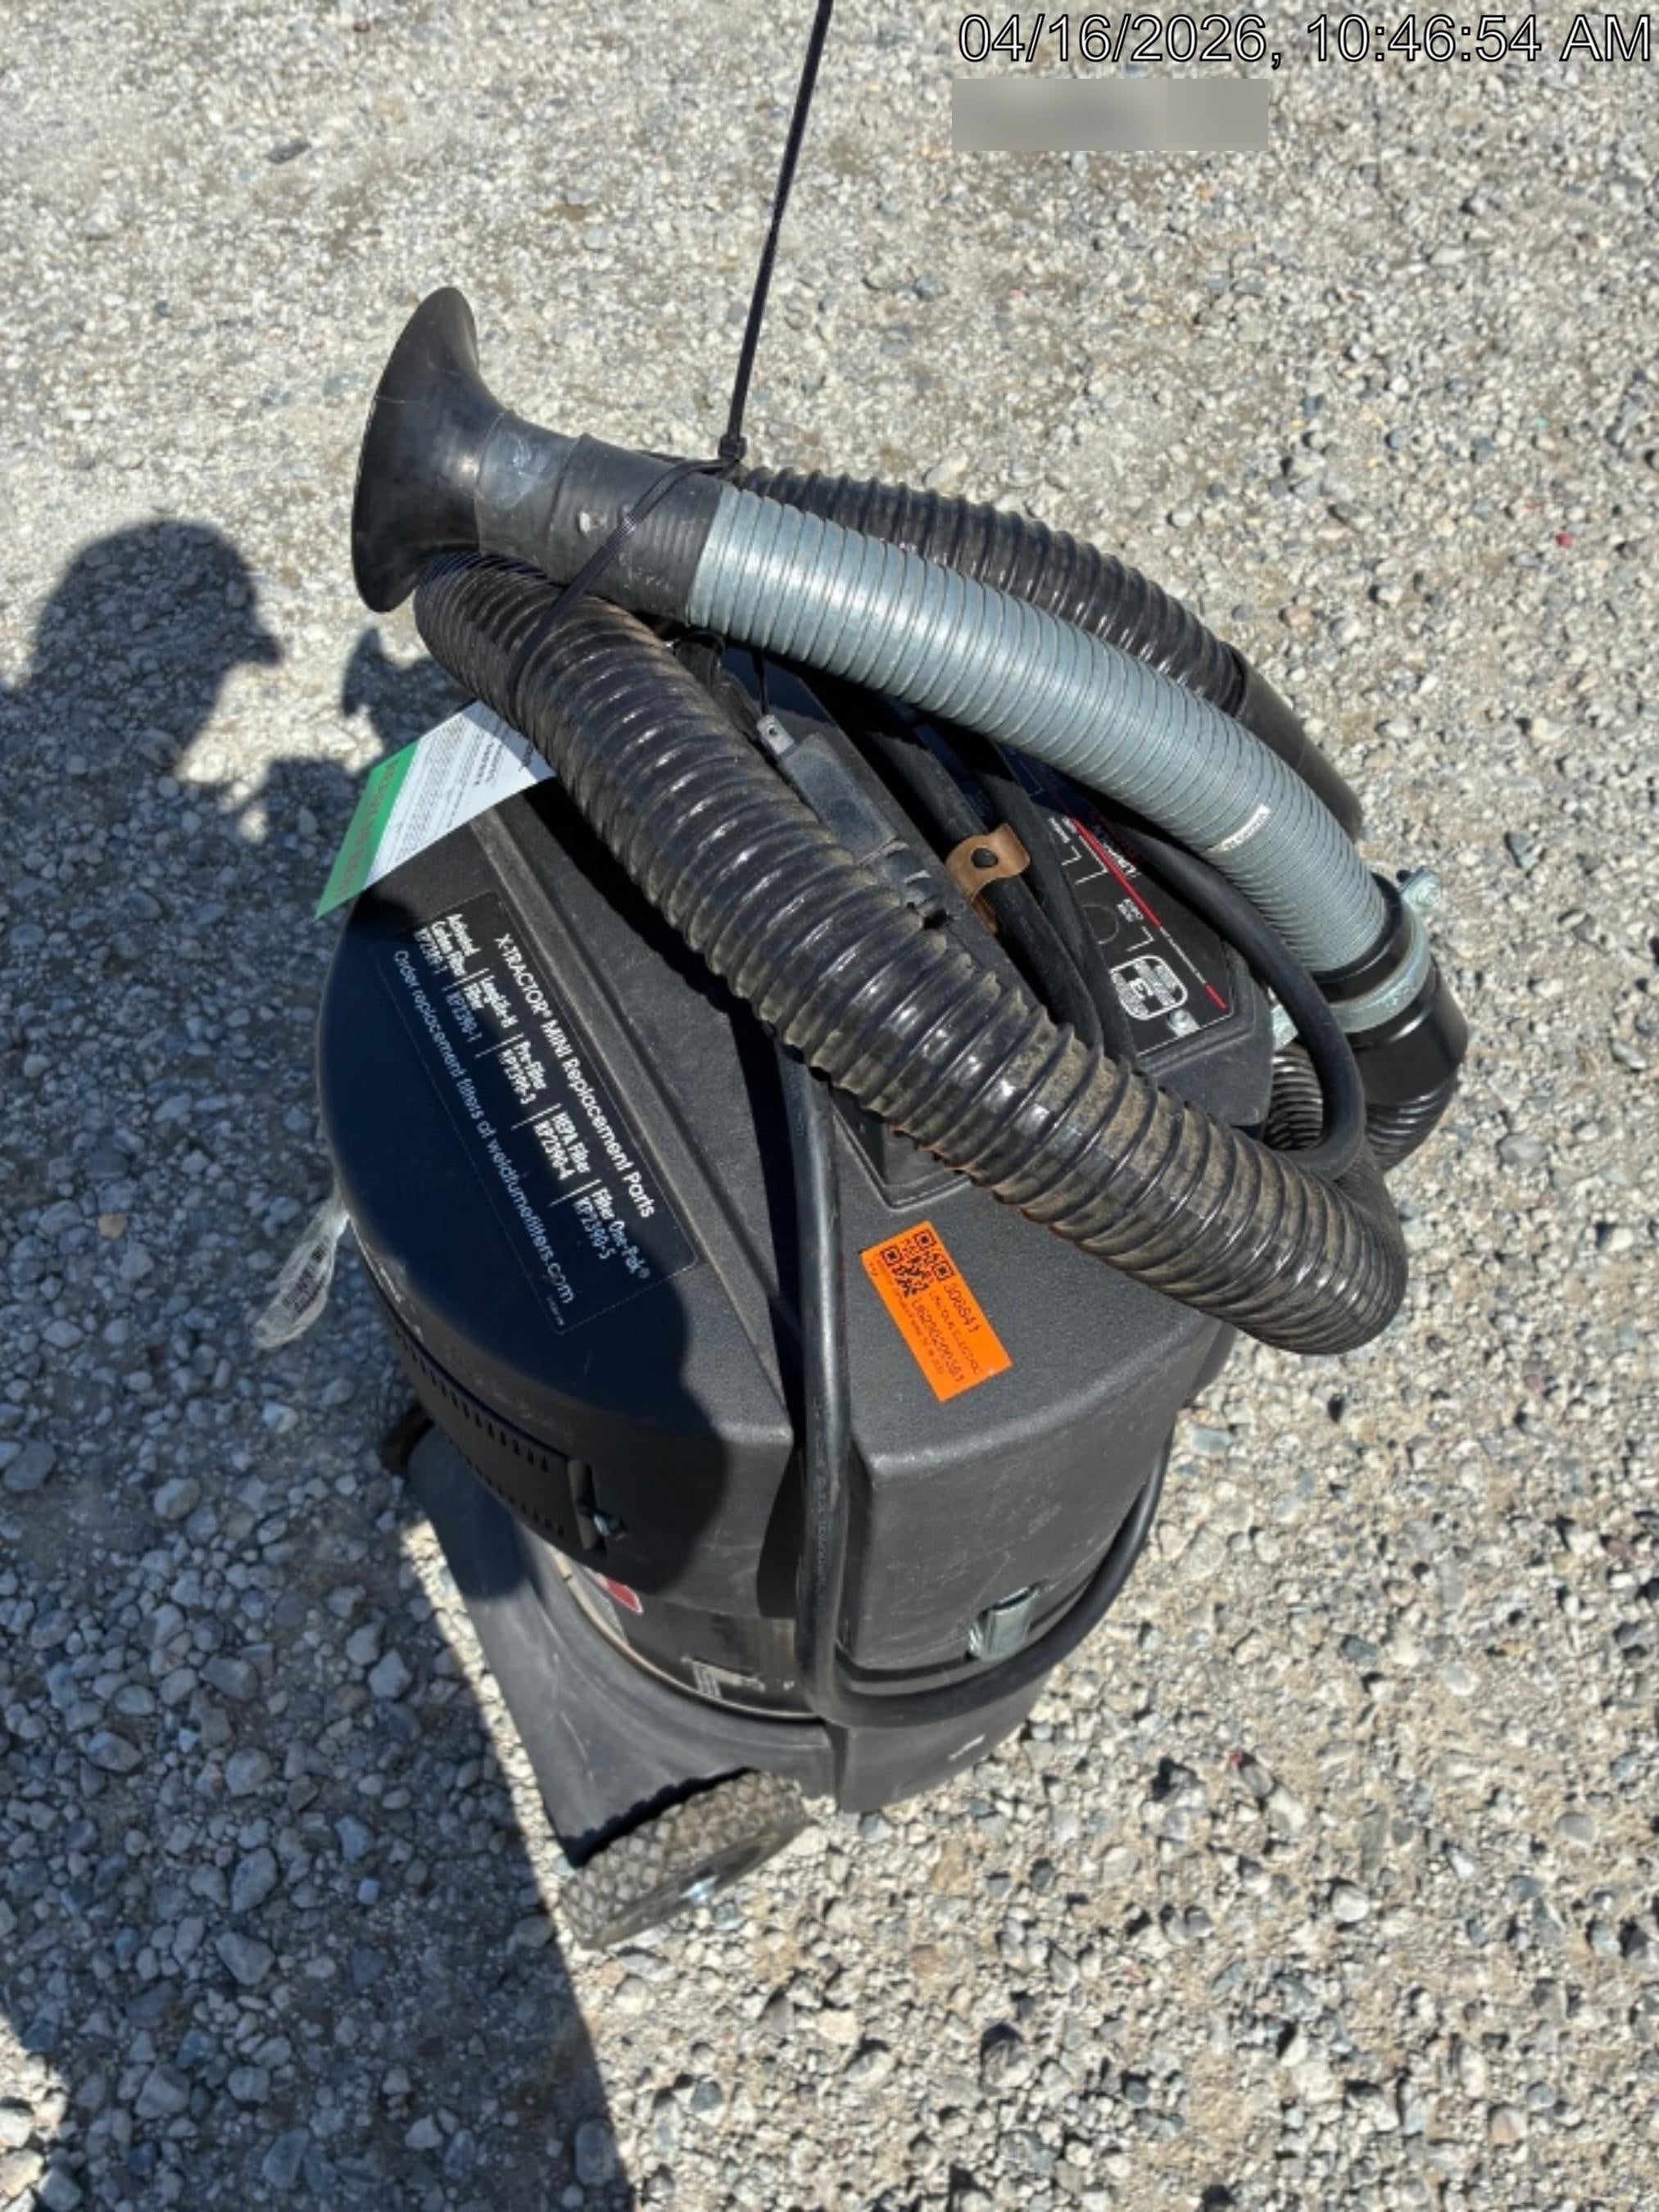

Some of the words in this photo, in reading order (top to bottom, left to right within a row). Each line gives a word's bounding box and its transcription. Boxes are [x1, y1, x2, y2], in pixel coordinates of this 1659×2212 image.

[394, 950, 419, 987] Order
[412, 990, 466, 1077] replacement
[456, 1078, 484, 1119] filters
[477, 1121, 496, 1138] at
[487, 1139, 573, 1303] weldfumefilters.com
[542, 1020, 573, 1058] MINI
[562, 1057, 633, 1171] Replacement
[623, 1172, 654, 1217] Parts
[552, 1113, 578, 1145] HEPA
[568, 1142, 590, 1173] Filter
[592, 1188, 614, 1219] Filter
